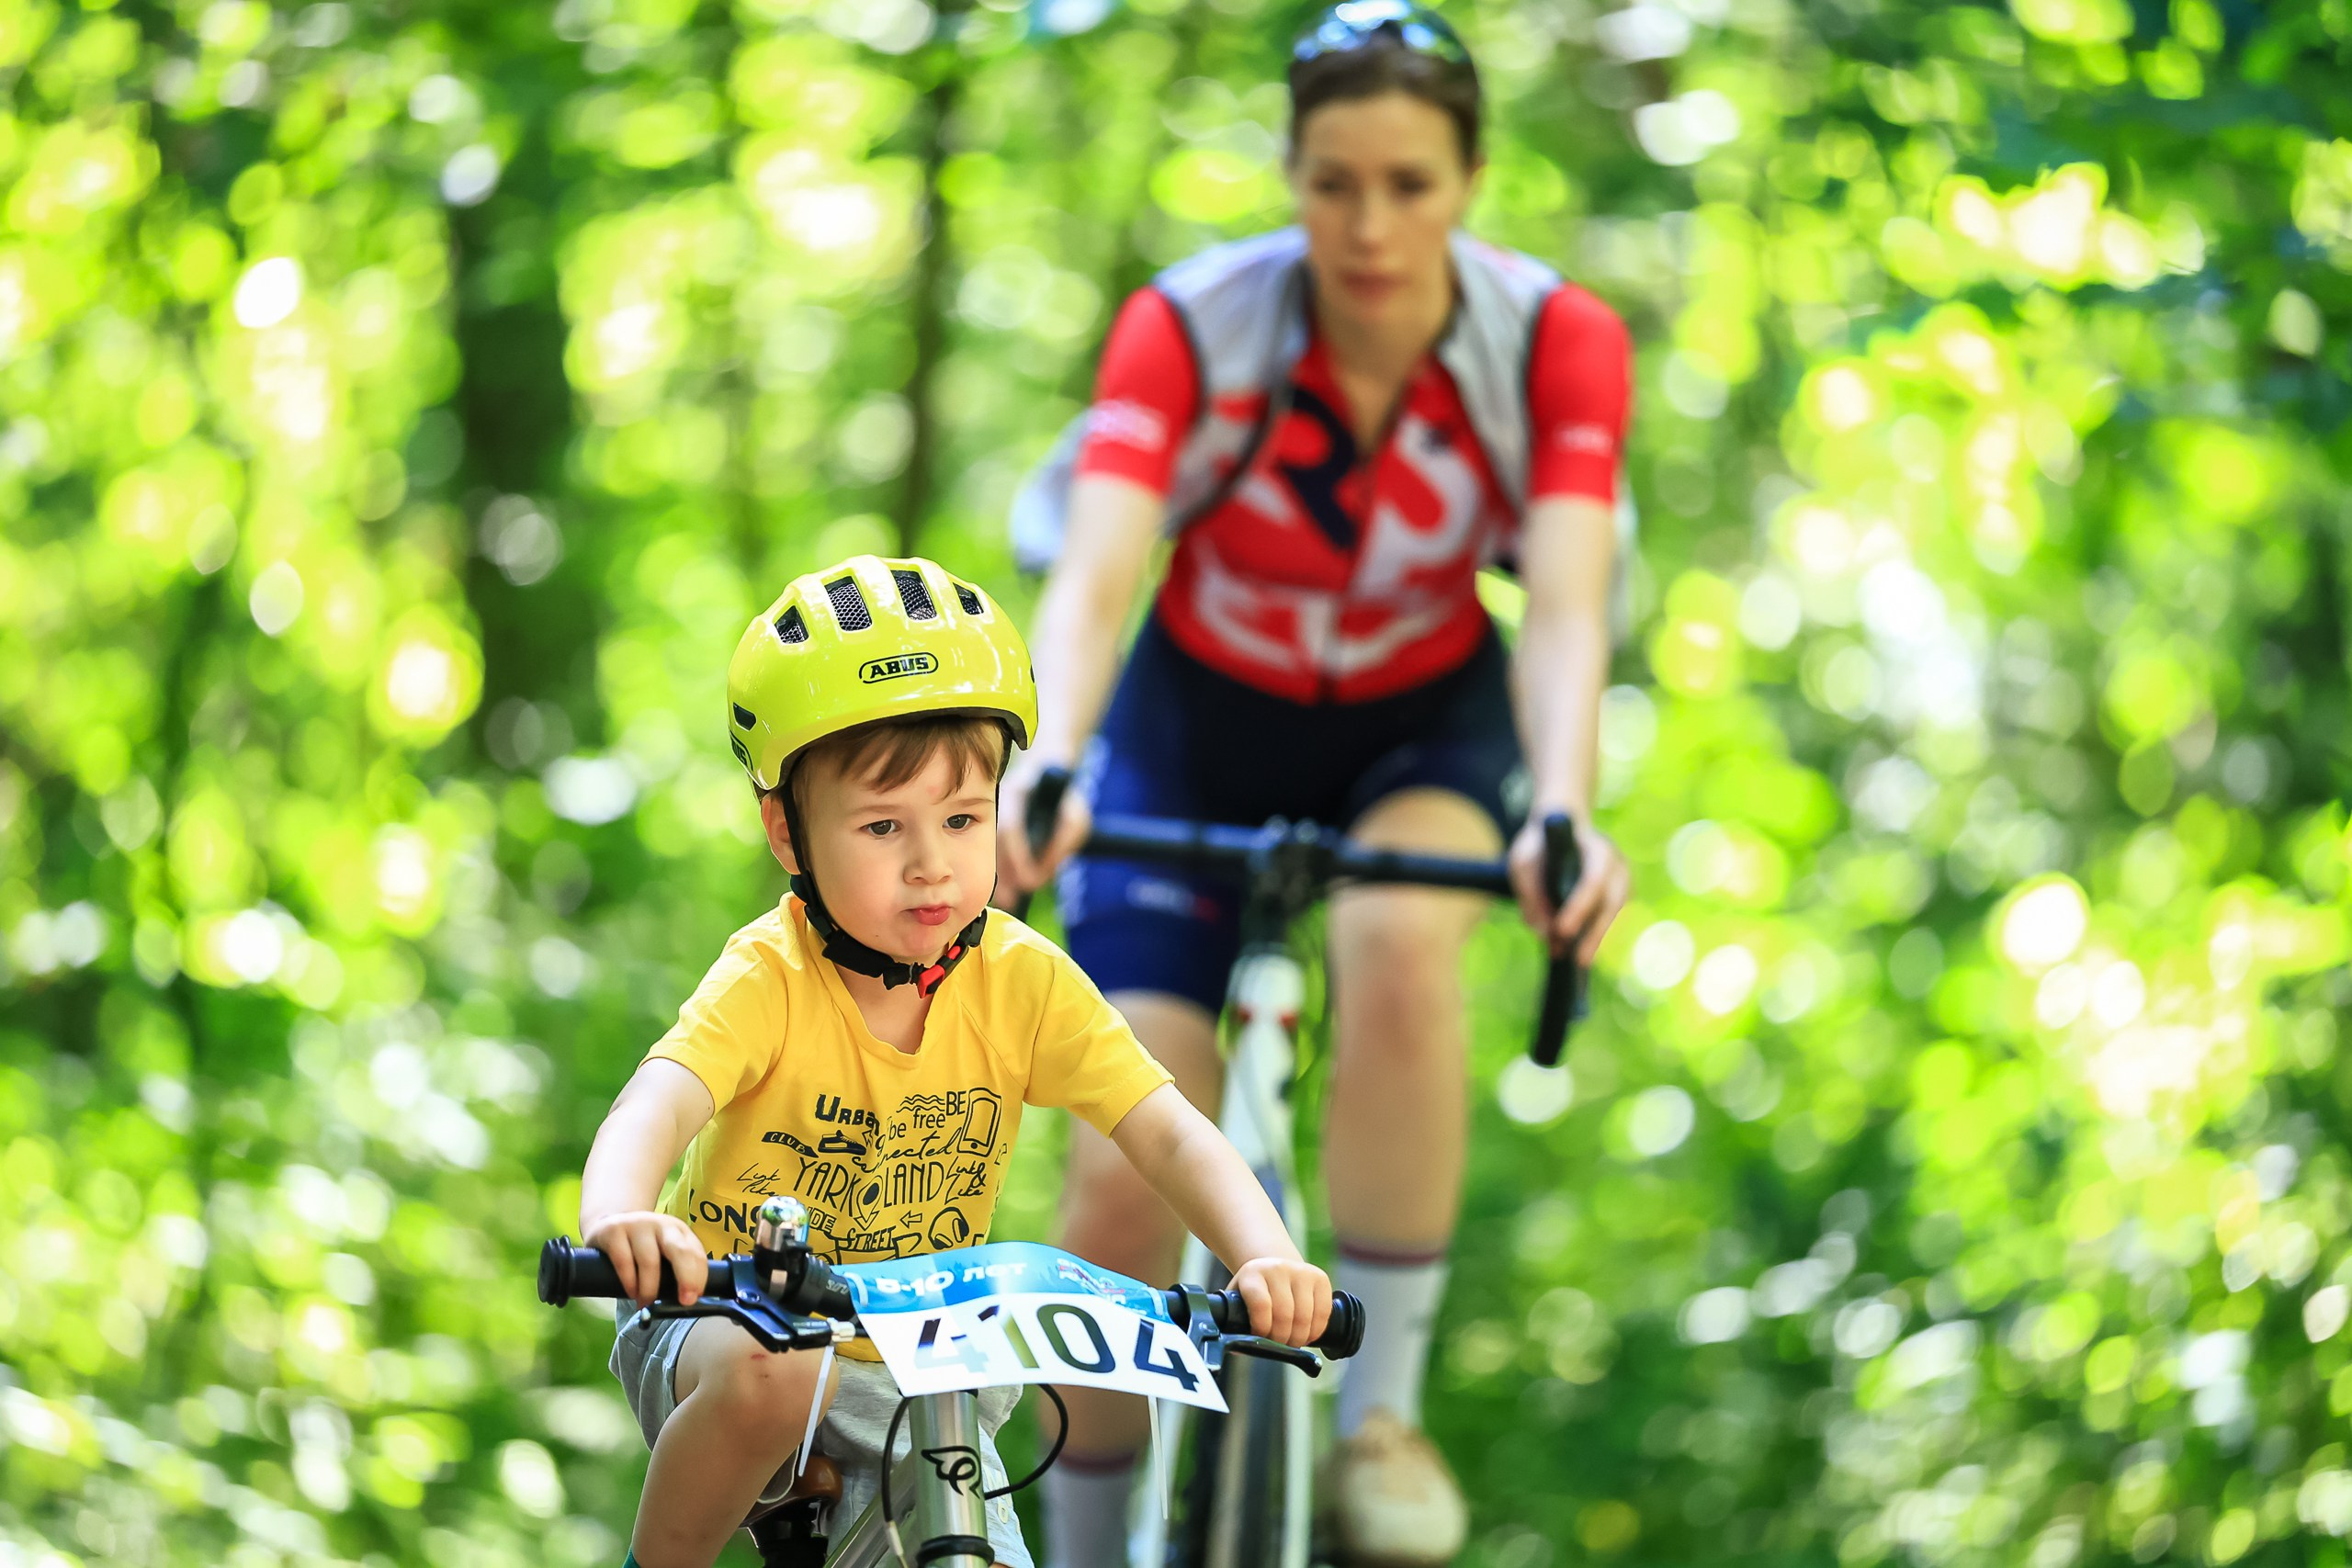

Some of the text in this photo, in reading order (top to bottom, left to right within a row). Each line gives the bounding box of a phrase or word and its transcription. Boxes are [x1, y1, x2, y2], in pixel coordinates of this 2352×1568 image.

[870, 657, 930, 679] ABUS
[946, 1090, 967, 1116] BE
[888, 1108, 946, 1141] be free
[769, 1133, 806, 1154] CLUB
[915, 1303, 1199, 1393] 4104
